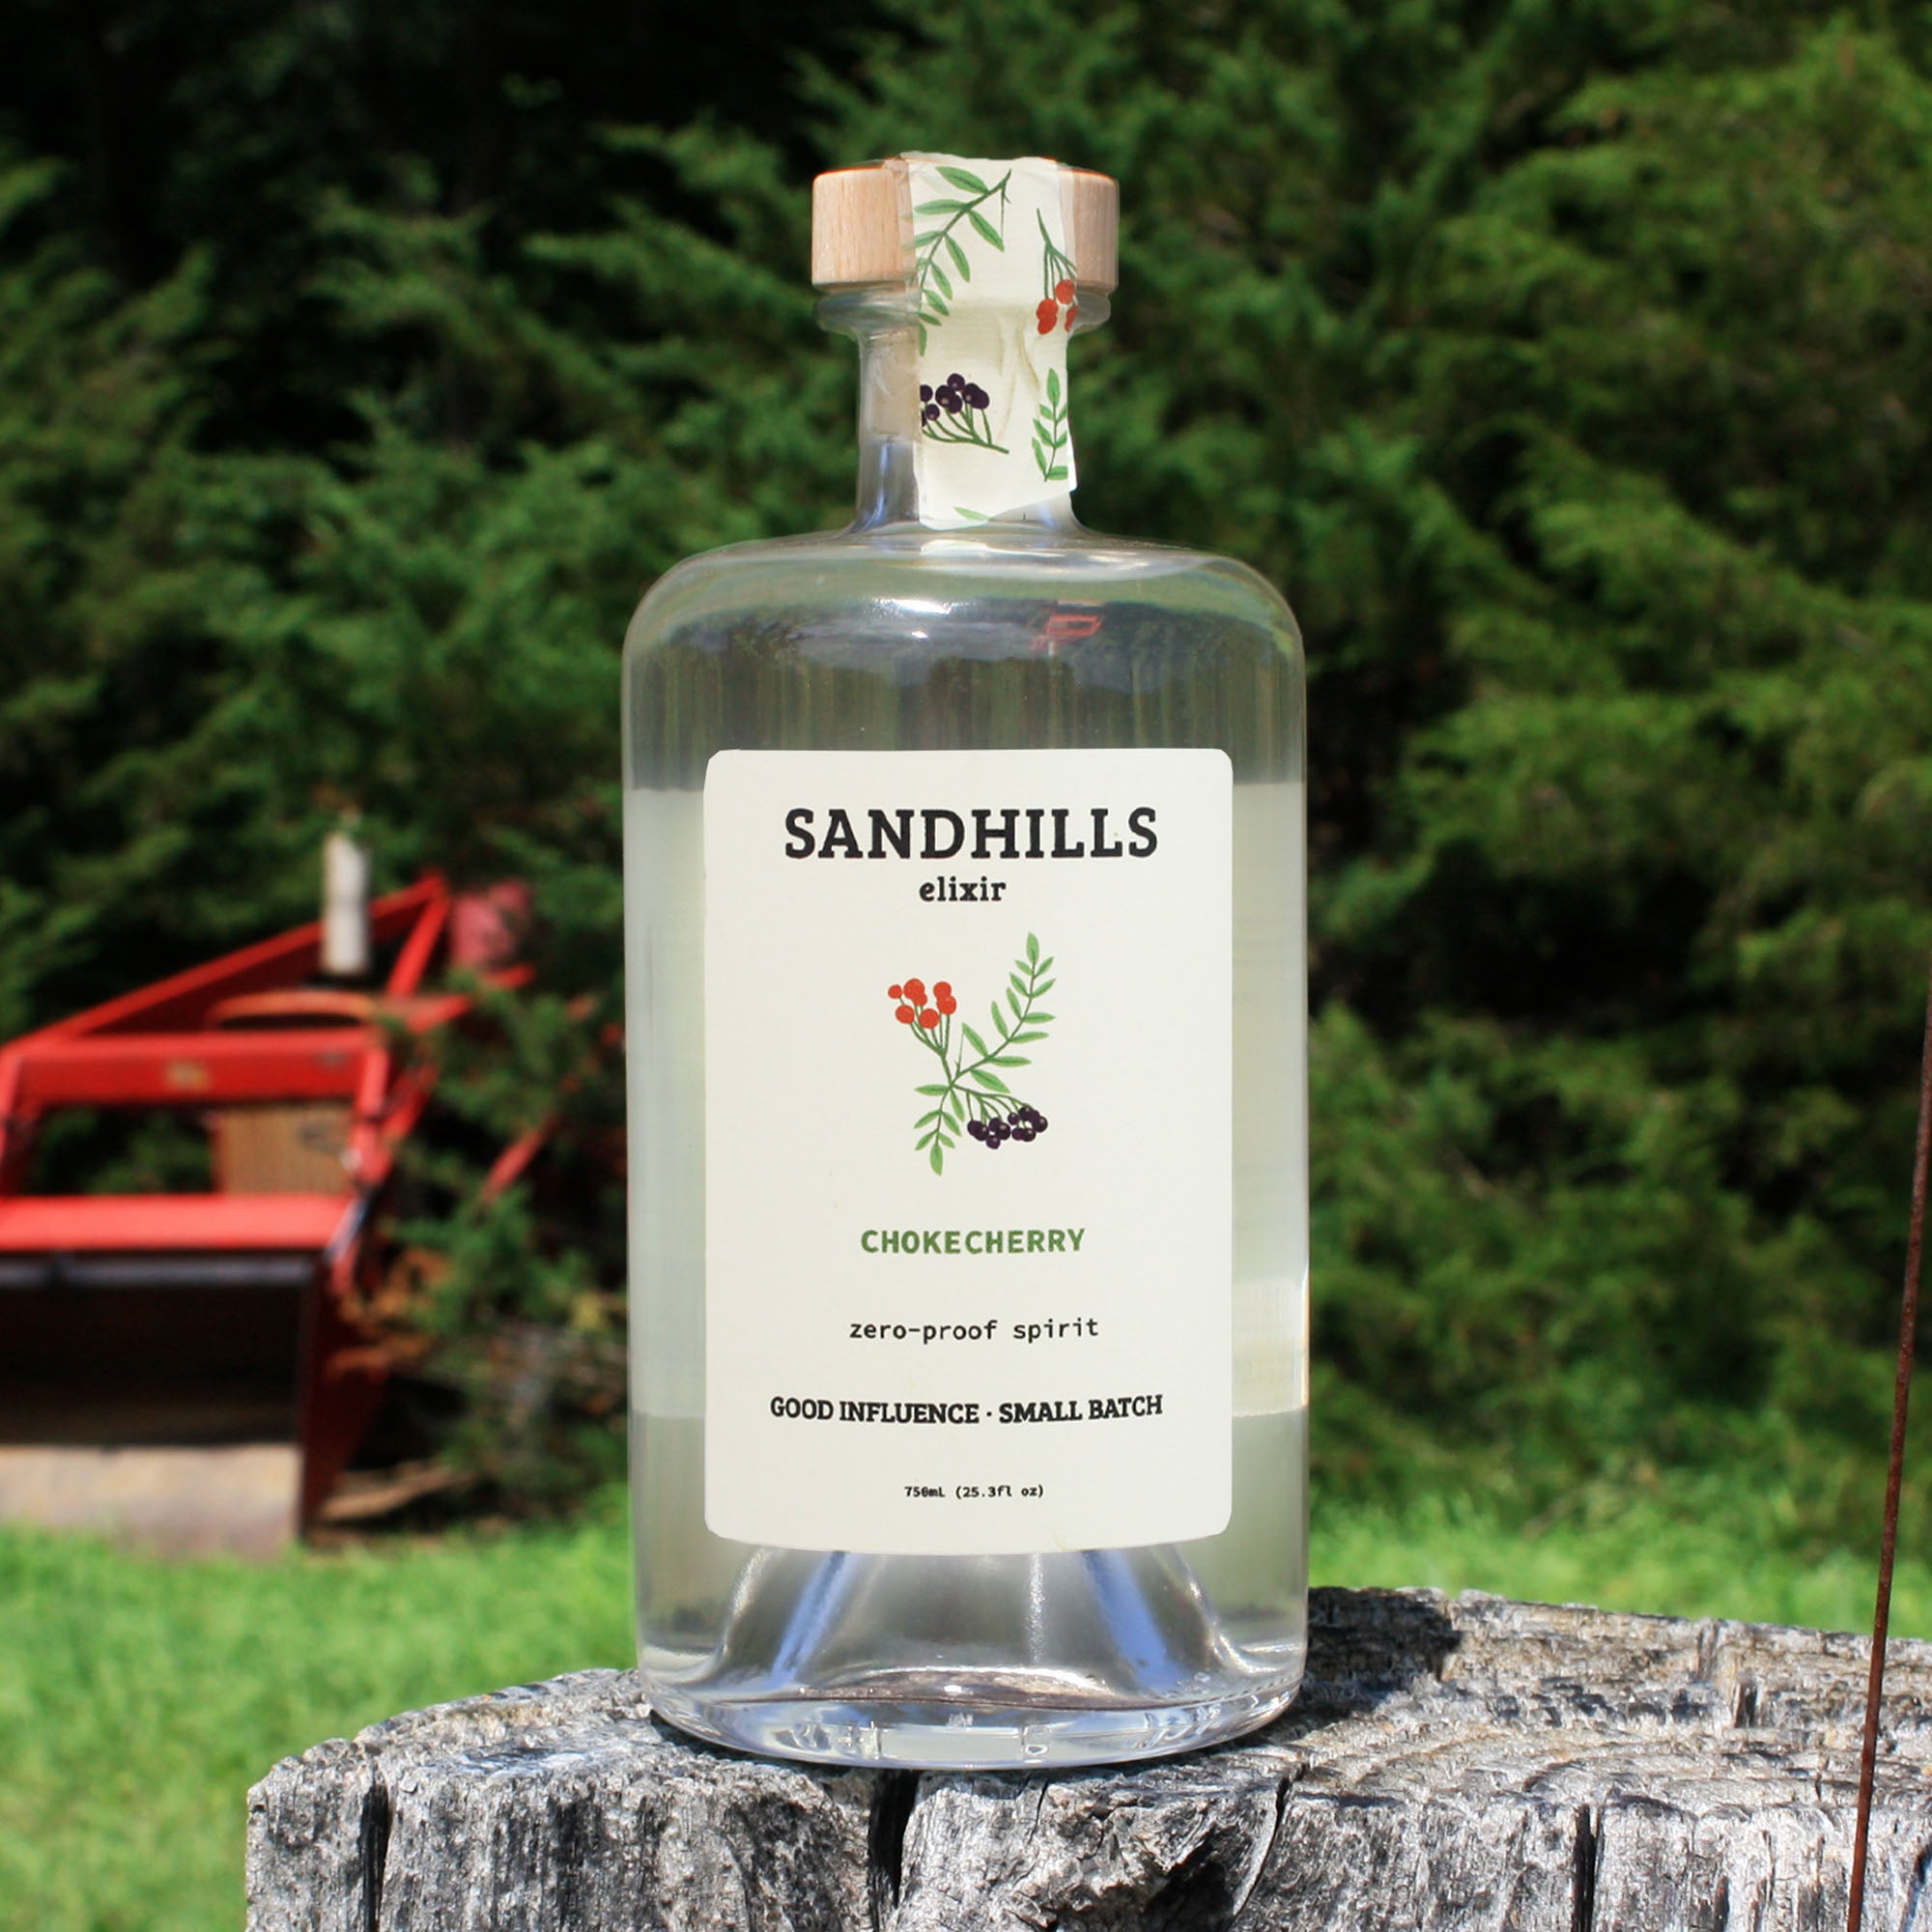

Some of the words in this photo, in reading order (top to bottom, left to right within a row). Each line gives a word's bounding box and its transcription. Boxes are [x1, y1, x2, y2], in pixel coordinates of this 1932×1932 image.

[784, 806, 1158, 860] SANDHILLS
[918, 875, 1007, 903] elixir
[860, 1228, 1086, 1255] CHOKECHERRY
[849, 1319, 998, 1346] zero-proof
[1012, 1317, 1099, 1345] spirit
[770, 1395, 835, 1421] GOOD
[838, 1400, 980, 1425] INFLUENCE
[998, 1400, 1084, 1425] SMALL
[1088, 1393, 1163, 1420] BATCH
[903, 1486, 946, 1498] 750mL
[954, 1484, 1012, 1500] (25.3fl
[1020, 1484, 1044, 1498] oz)
